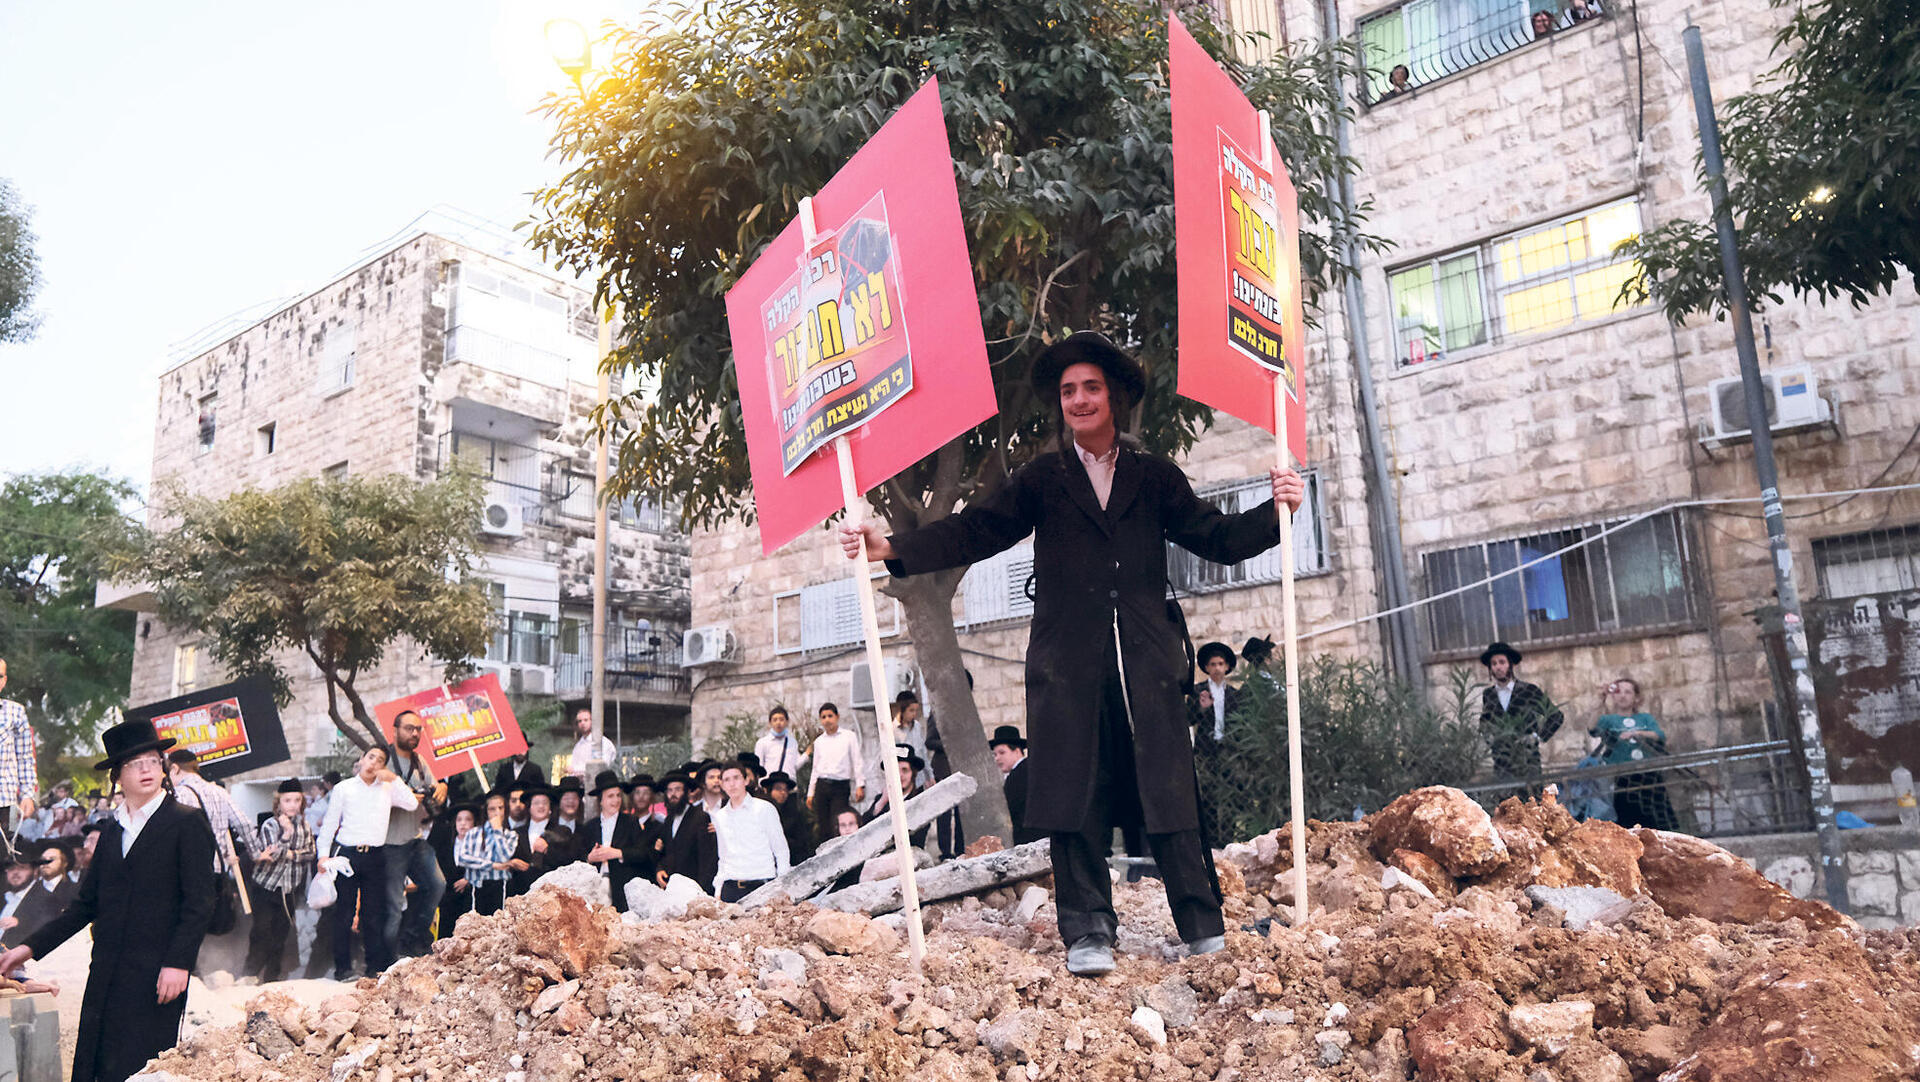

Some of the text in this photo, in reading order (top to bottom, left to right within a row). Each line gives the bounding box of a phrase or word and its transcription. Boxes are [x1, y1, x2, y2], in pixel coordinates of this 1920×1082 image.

[1222, 143, 1257, 196] הקלה
[1229, 185, 1277, 281] עבור
[850, 270, 892, 345] לא
[1232, 268, 1282, 325] כונתינו!
[869, 377, 890, 405] היא
[891, 367, 904, 387] כי
[826, 393, 868, 428] נעיצת
